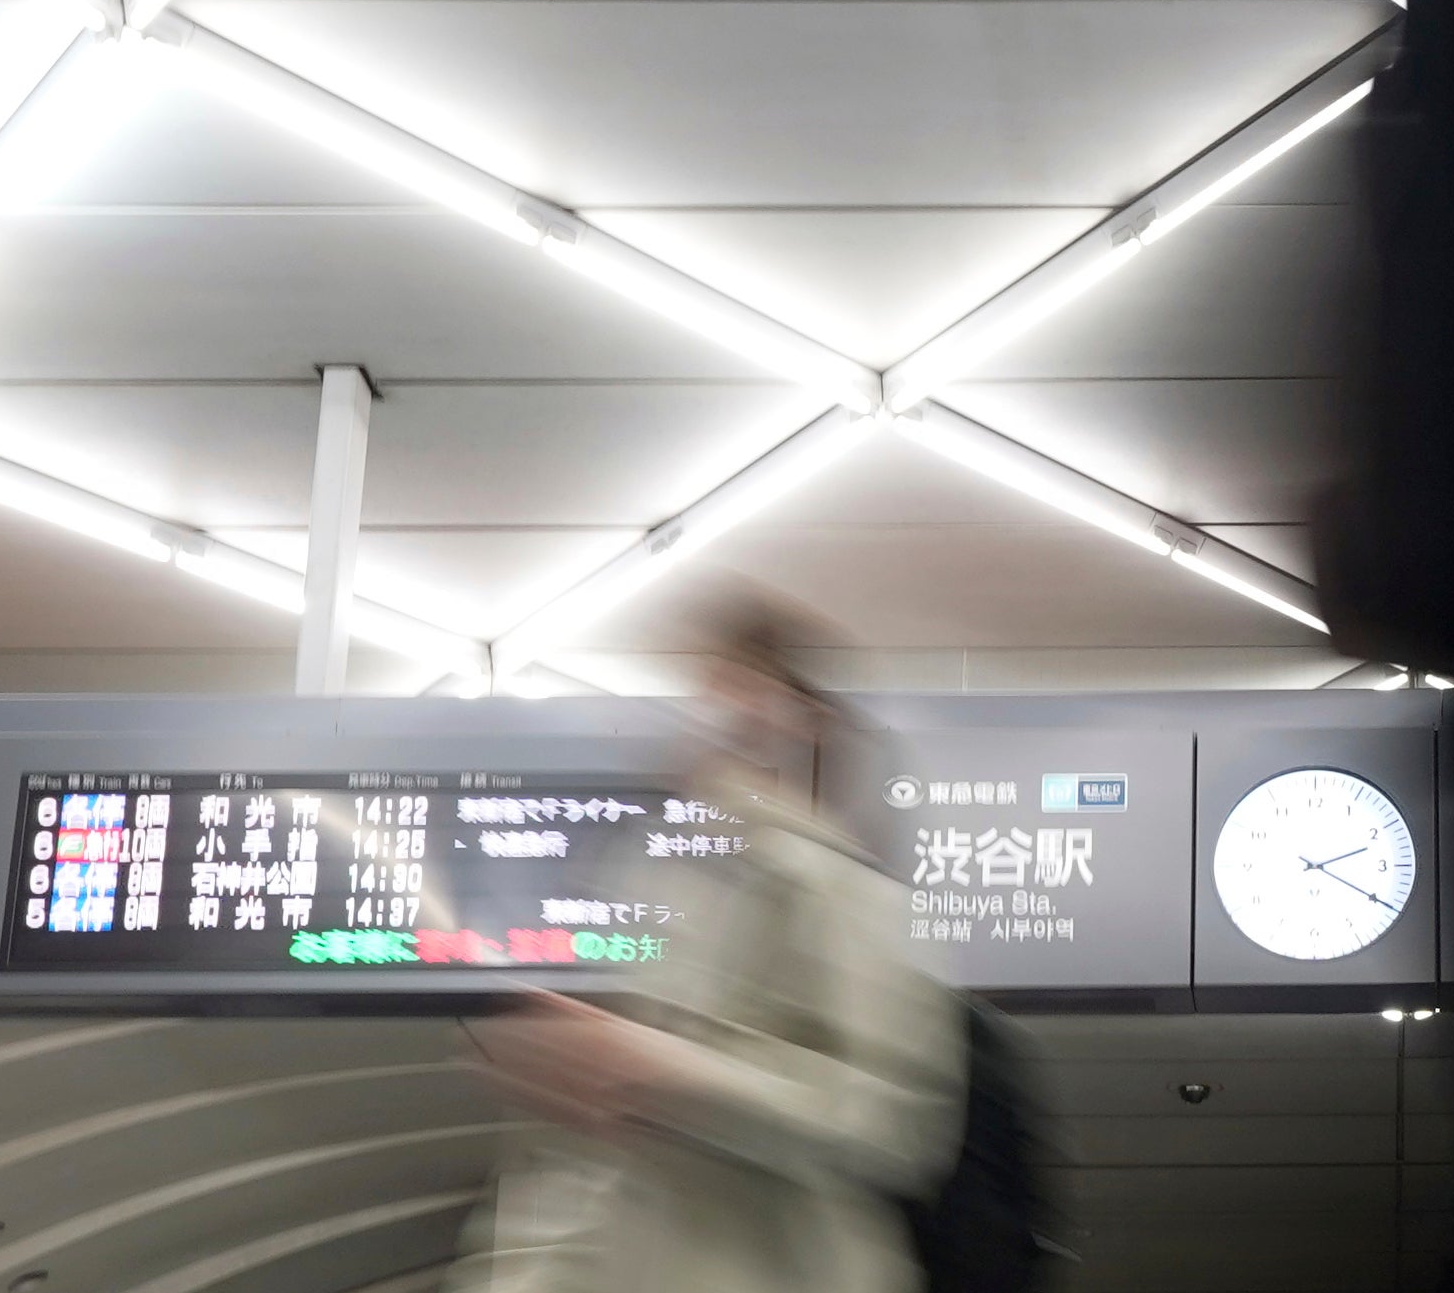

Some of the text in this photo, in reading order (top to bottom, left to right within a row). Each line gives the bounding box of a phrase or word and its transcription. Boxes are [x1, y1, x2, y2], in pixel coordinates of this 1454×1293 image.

[928, 781, 1018, 806] 東急電鉄
[199, 794, 322, 828] 和光市
[354, 795, 428, 826] 14:22
[351, 829, 426, 860] 14:25
[1368, 826, 1380, 841] 2
[912, 826, 1094, 888] 渋谷駅
[1377, 858, 1388, 873] 3
[188, 895, 313, 930] 和光市
[910, 889, 1057, 921] Shibuya Sta.
[989, 917, 1075, 944] 시부야역
